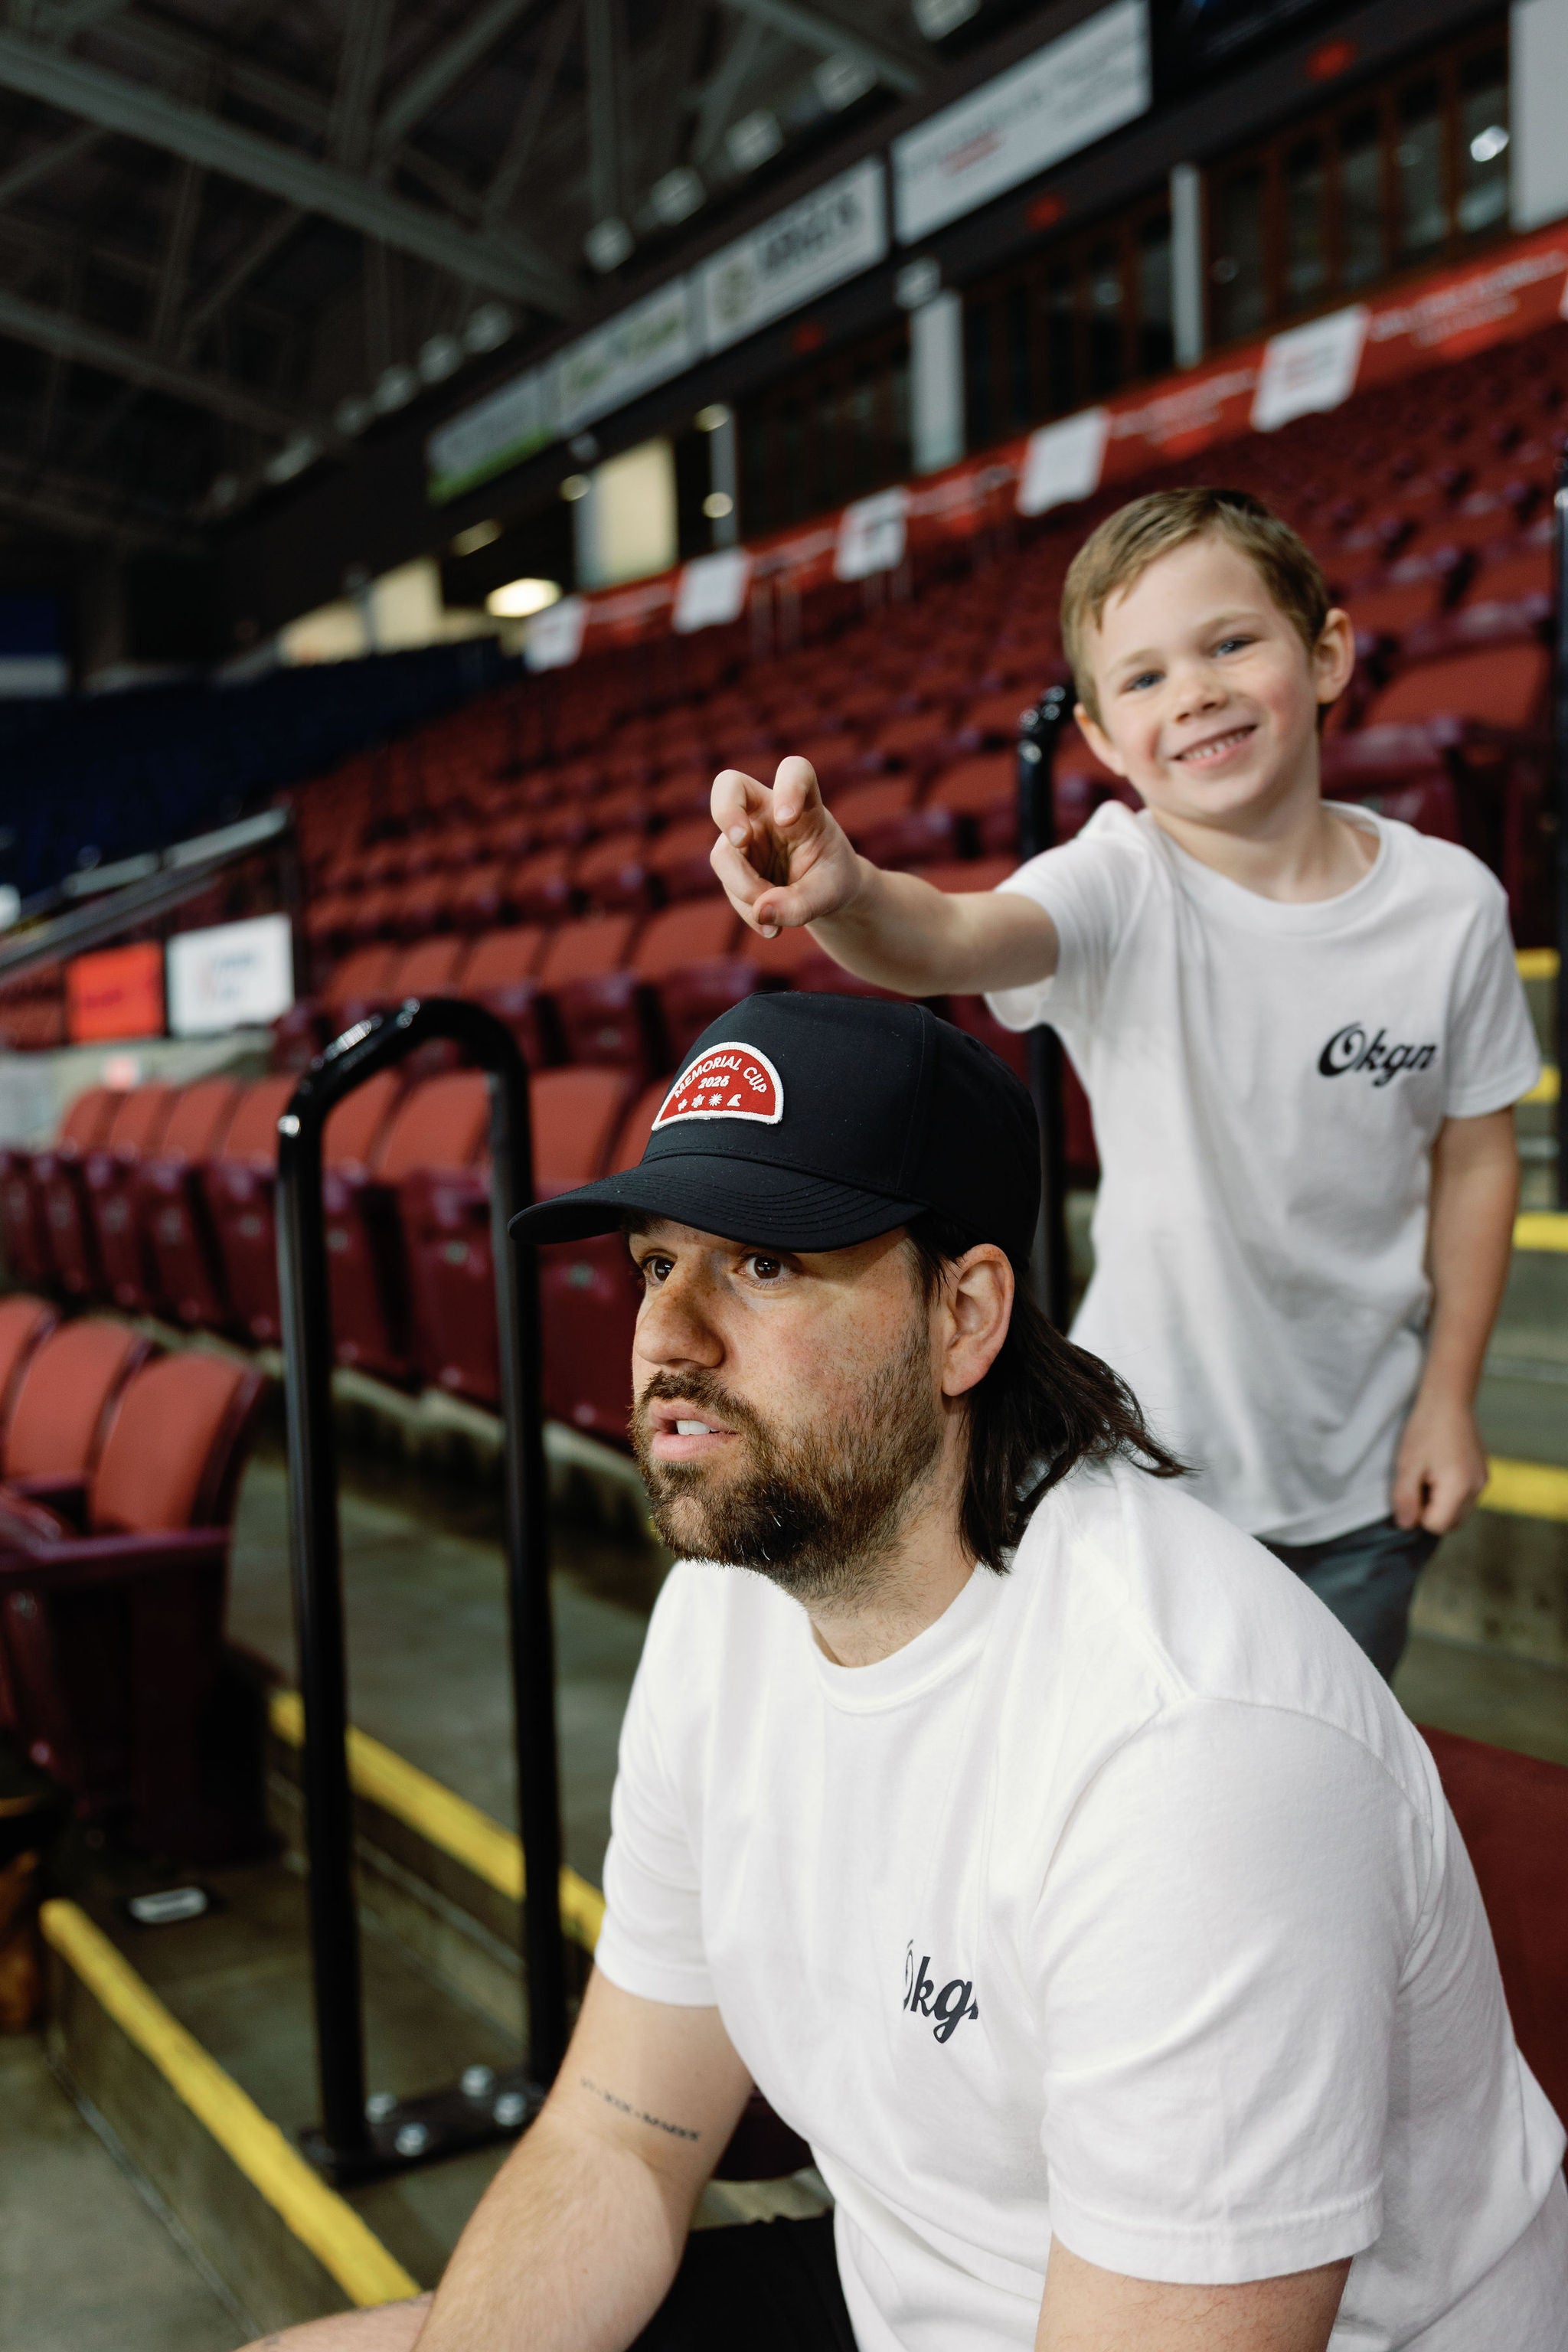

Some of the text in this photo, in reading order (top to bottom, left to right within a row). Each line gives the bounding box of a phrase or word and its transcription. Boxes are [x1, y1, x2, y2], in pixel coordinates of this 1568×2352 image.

[1317, 1021, 1437, 1087] Okgn
[675, 1055, 767, 1098] MEMORIAL CUP
[697, 1075, 730, 1089] 2026
